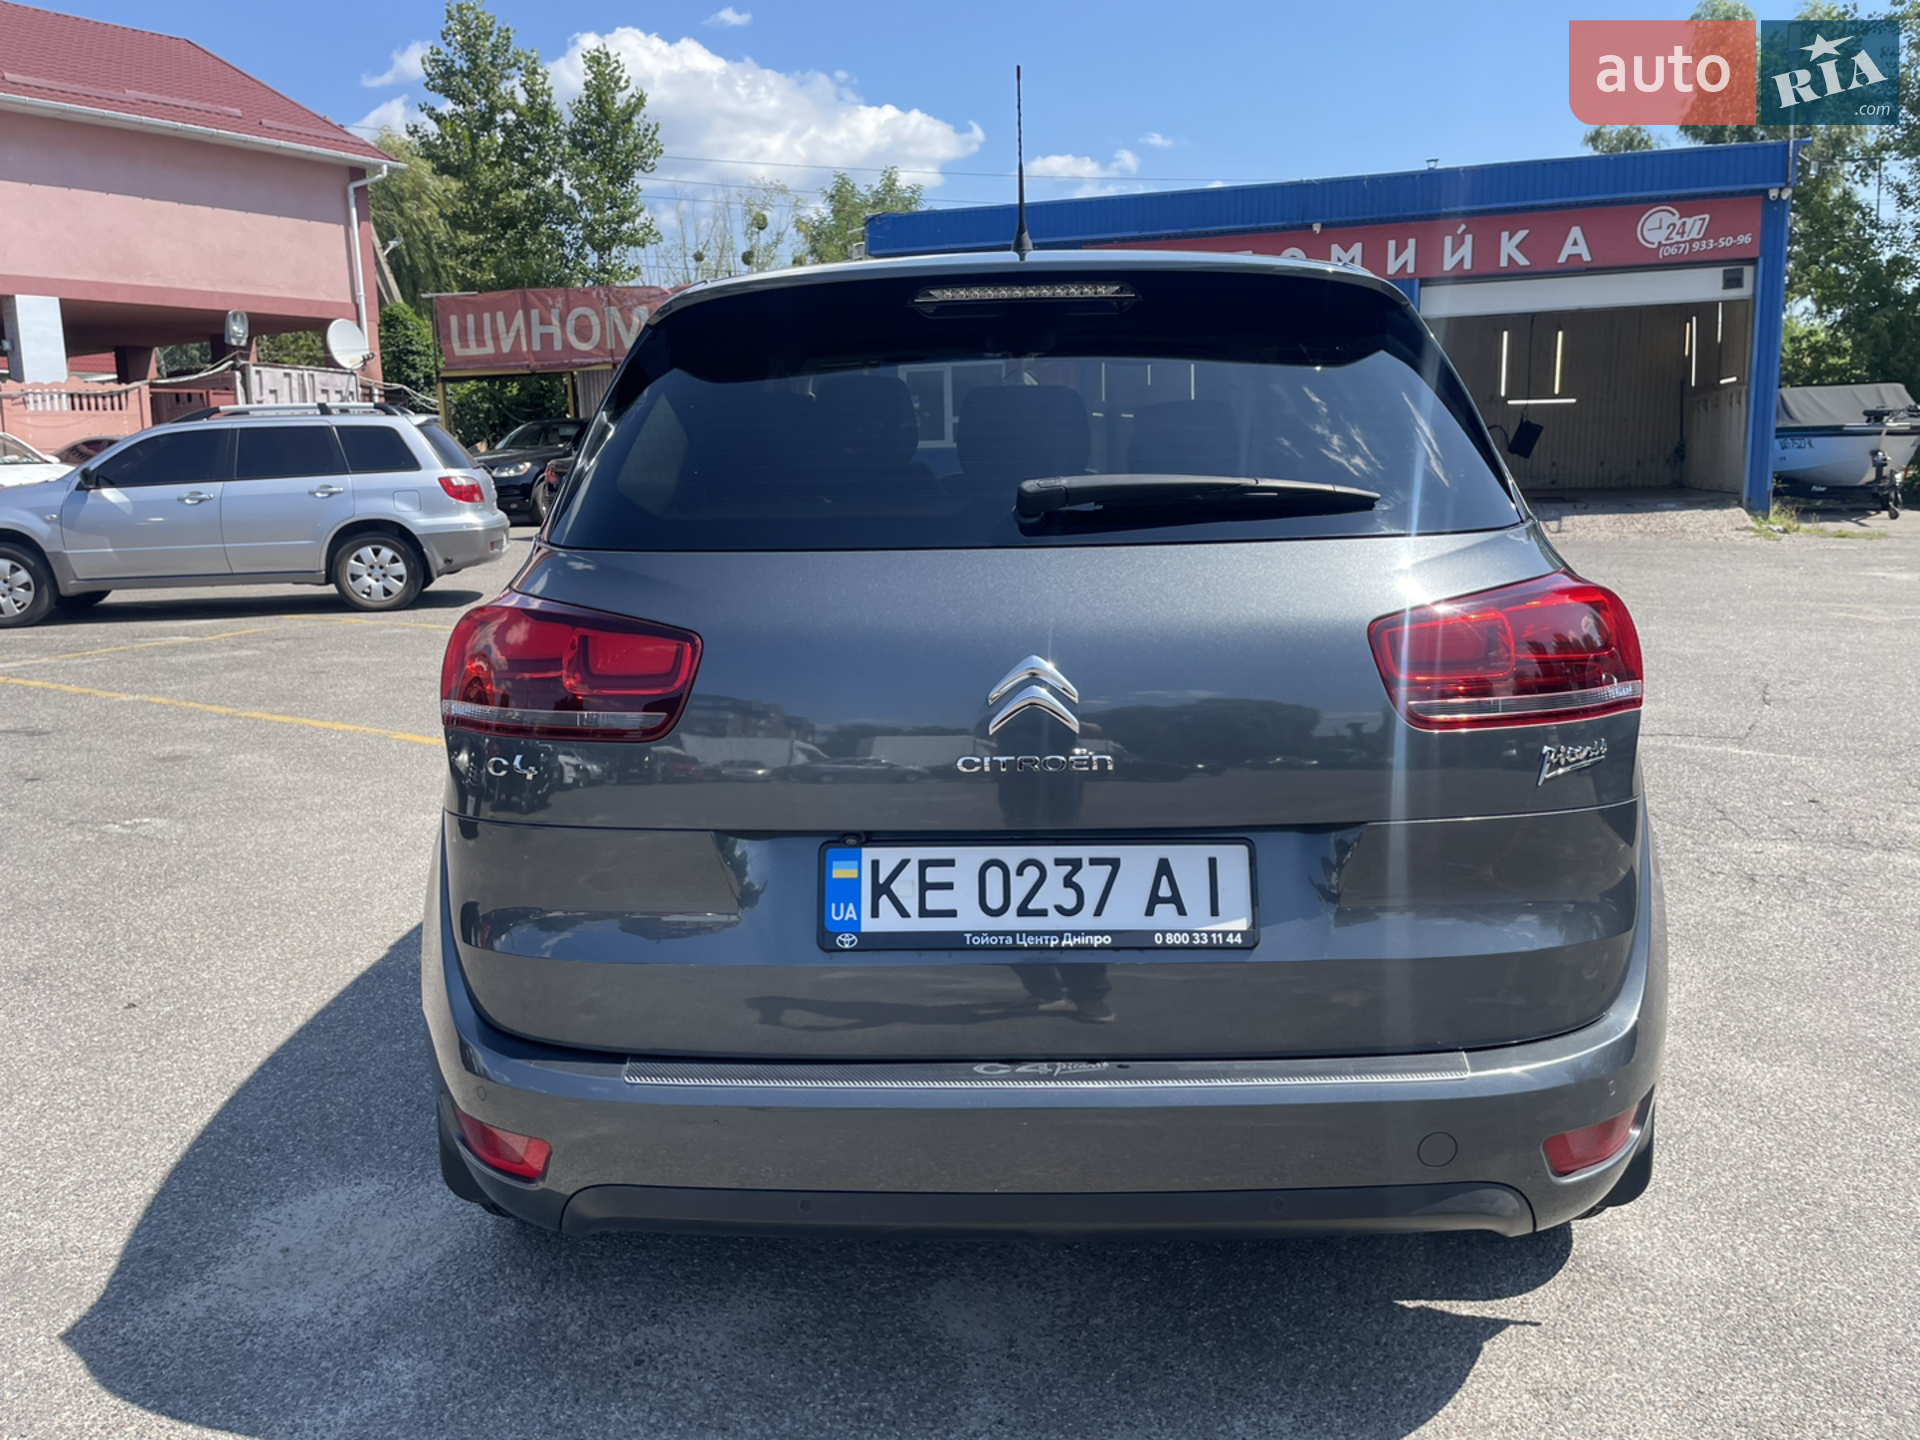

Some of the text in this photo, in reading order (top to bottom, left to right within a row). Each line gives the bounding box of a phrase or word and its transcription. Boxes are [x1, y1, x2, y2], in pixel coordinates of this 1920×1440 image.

[1664, 216, 1707, 241] 24/7
[1237, 223, 1592, 278] МИЙКА
[1659, 233, 1752, 259] (067) 933-50-96
[487, 755, 538, 780] C4
[870, 858, 957, 919] KE
[978, 857, 1121, 918] 0237
[831, 902, 858, 921] UA
[964, 932, 1112, 947] Тойота Центр Дніпро
[1154, 932, 1163, 945] 0
[1165, 932, 1190, 945] 800
